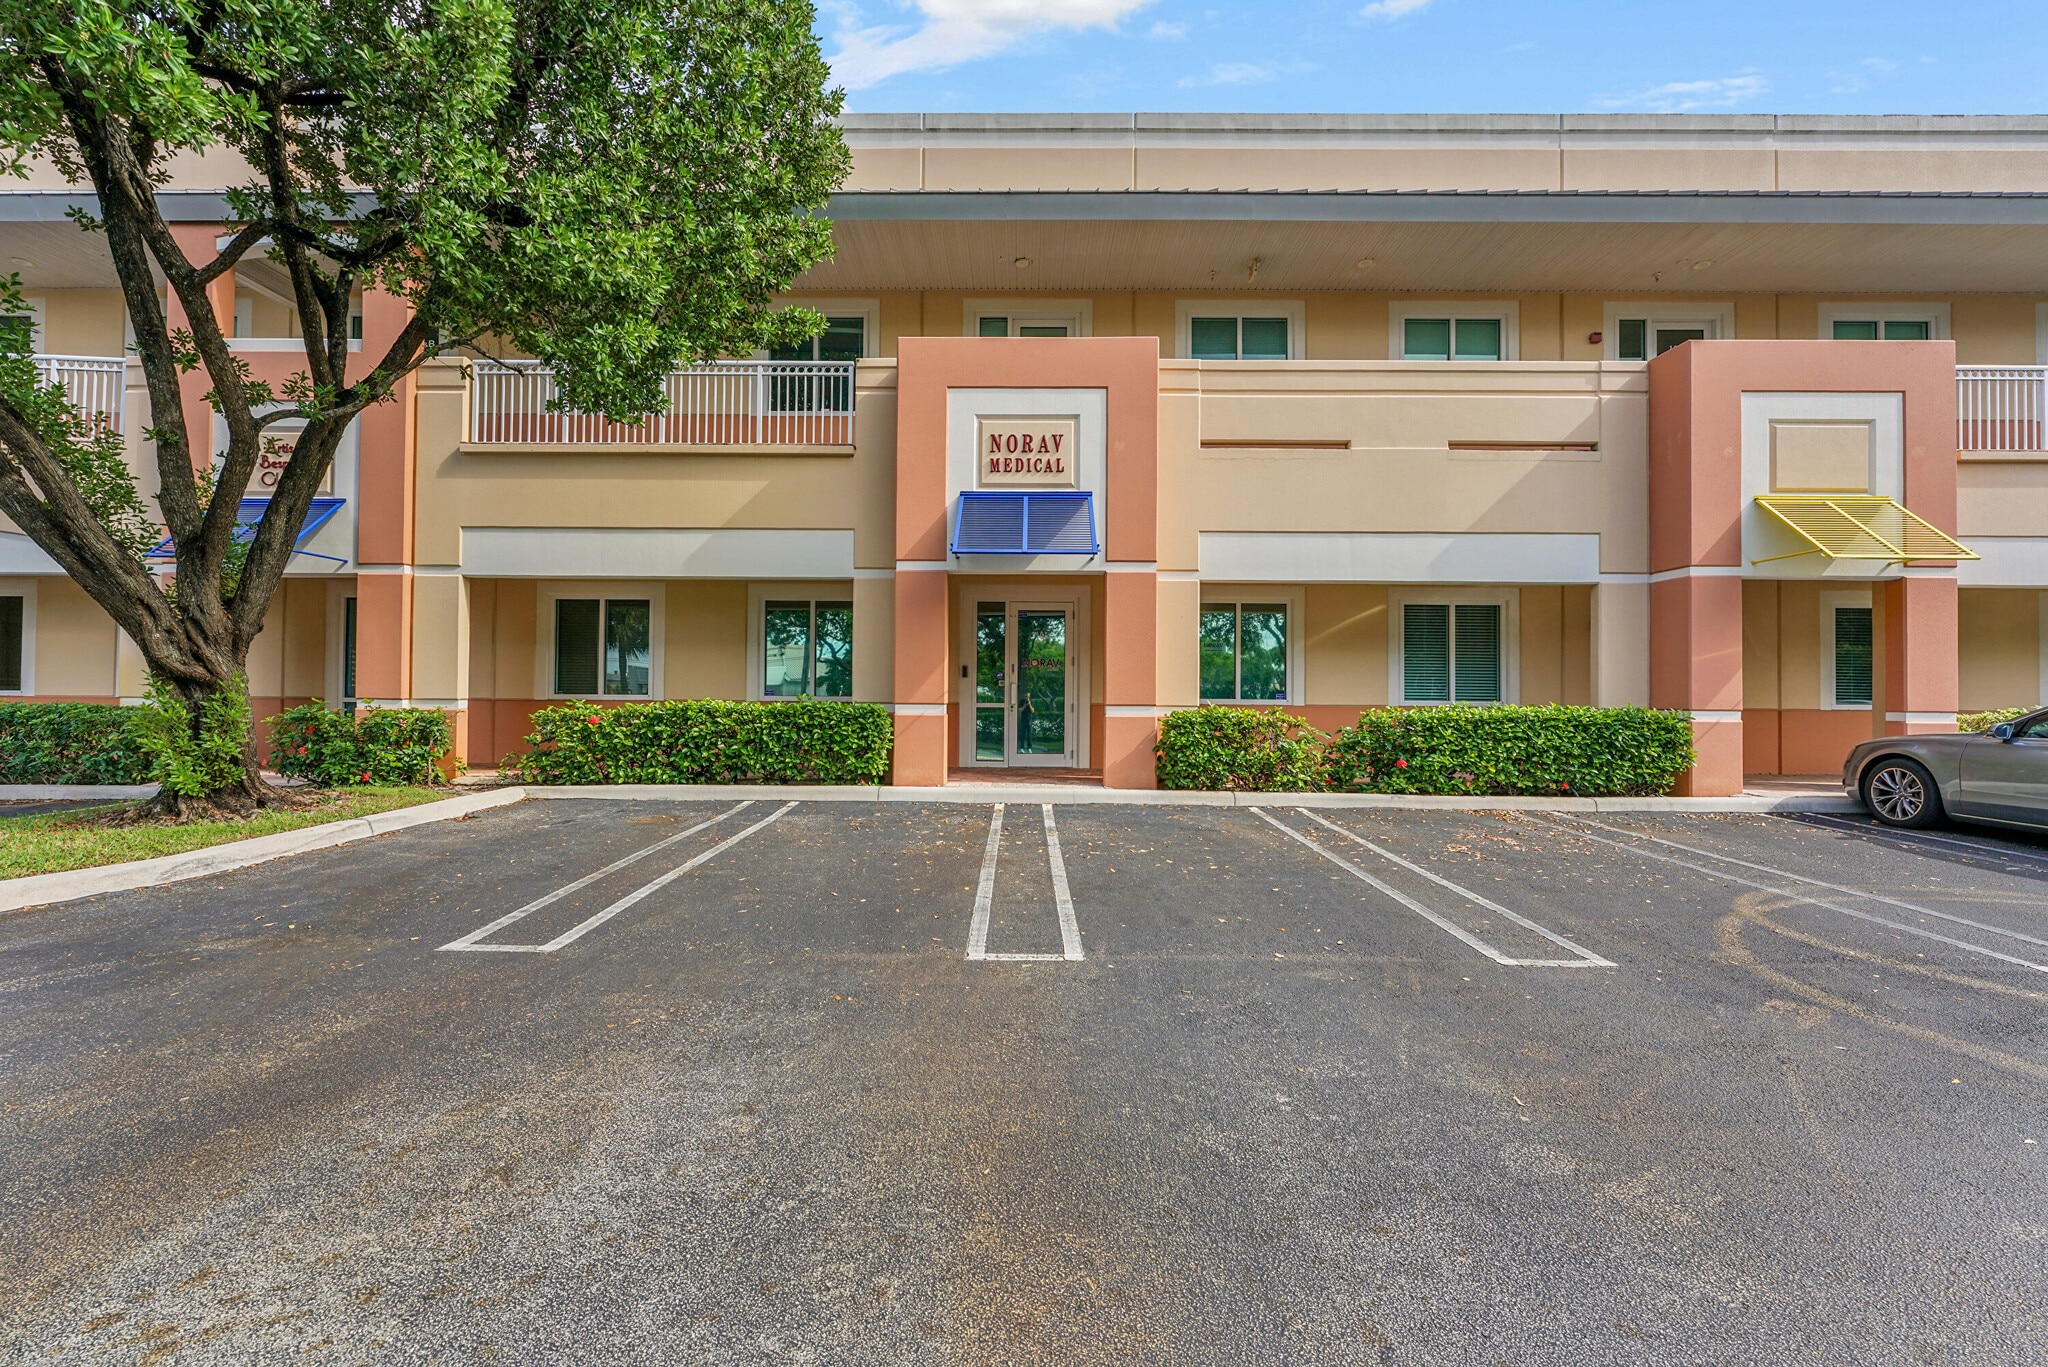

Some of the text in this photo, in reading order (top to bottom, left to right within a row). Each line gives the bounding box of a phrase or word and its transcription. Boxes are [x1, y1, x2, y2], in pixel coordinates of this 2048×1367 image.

[990, 434, 1064, 453] NORAV
[989, 458, 1065, 473] MEDICAL
[1022, 658, 1060, 668] NORAV
